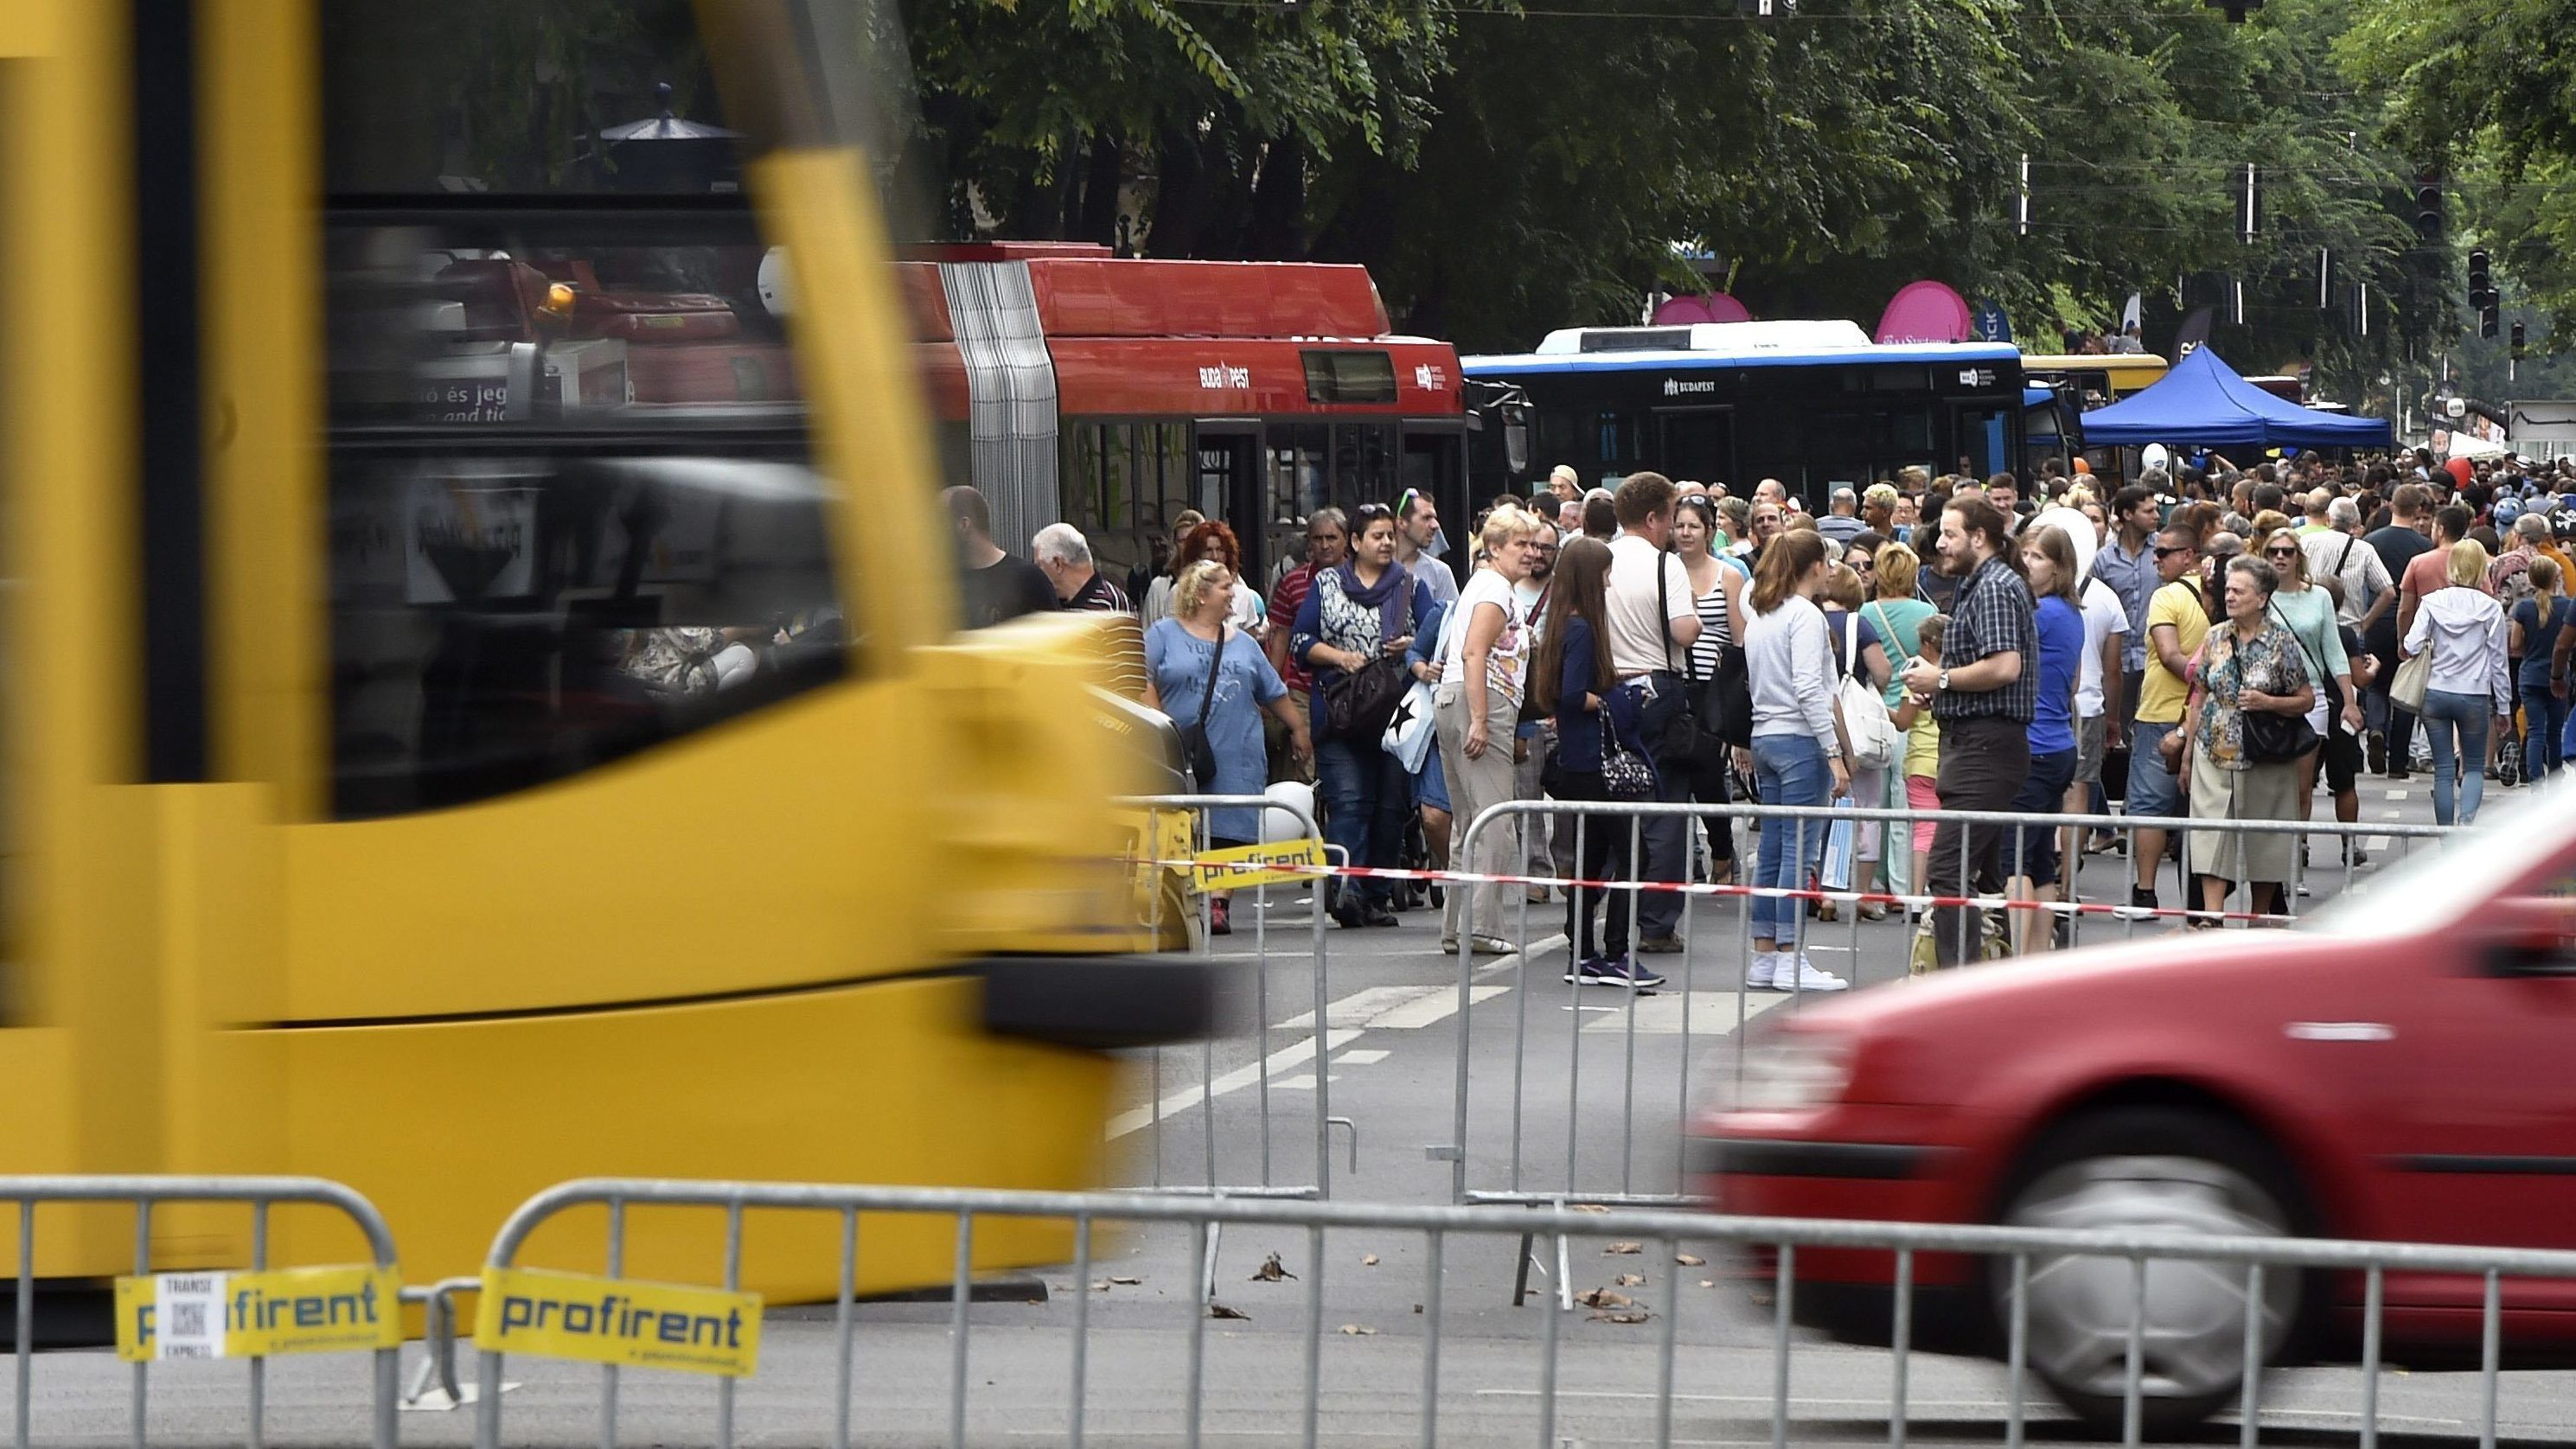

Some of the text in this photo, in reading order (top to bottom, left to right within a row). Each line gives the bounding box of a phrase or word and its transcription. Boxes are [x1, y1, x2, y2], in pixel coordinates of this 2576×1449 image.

[1679, 381, 1715, 392] BUDAPEST
[137, 1280, 378, 1345] pfirent
[501, 1295, 741, 1349] profirent
